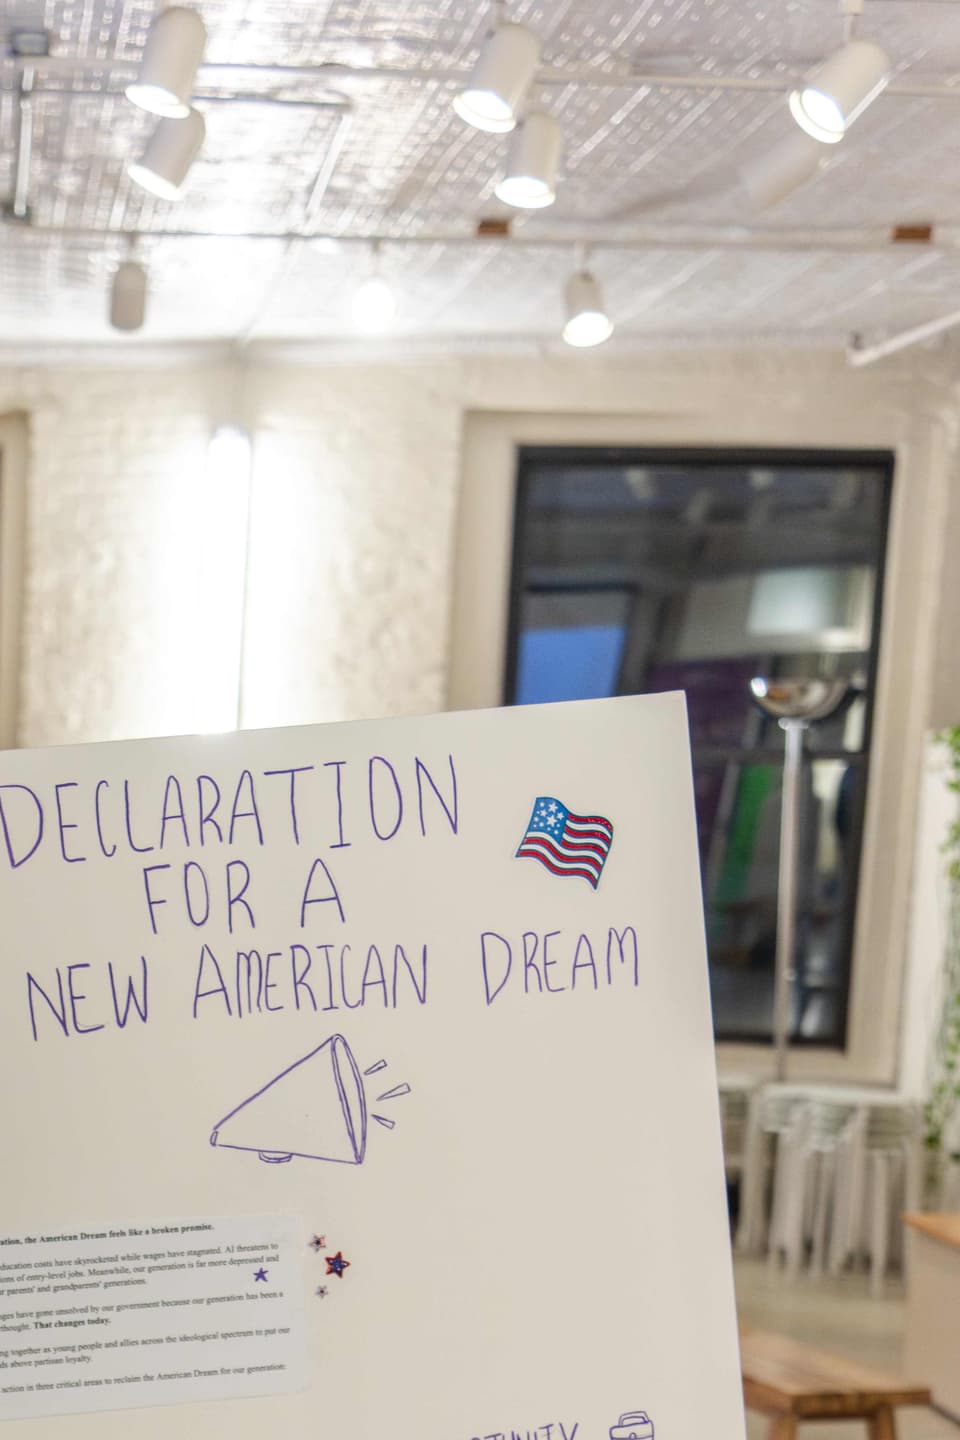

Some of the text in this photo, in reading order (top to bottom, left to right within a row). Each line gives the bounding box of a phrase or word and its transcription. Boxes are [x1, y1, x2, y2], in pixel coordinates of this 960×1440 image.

[143, 857, 346, 936] FOR A
[25, 926, 640, 1041] NEW AMERICAN DREAM
[24, 1235, 36, 1244] the
[39, 1232, 78, 1242] American
[79, 1230, 106, 1240] Dream
[108, 1228, 126, 1237] feels
[128, 1227, 142, 1236] like
[151, 1224, 178, 1234] broken
[34, 1320, 52, 1329] That
[53, 1317, 85, 1329] changes
